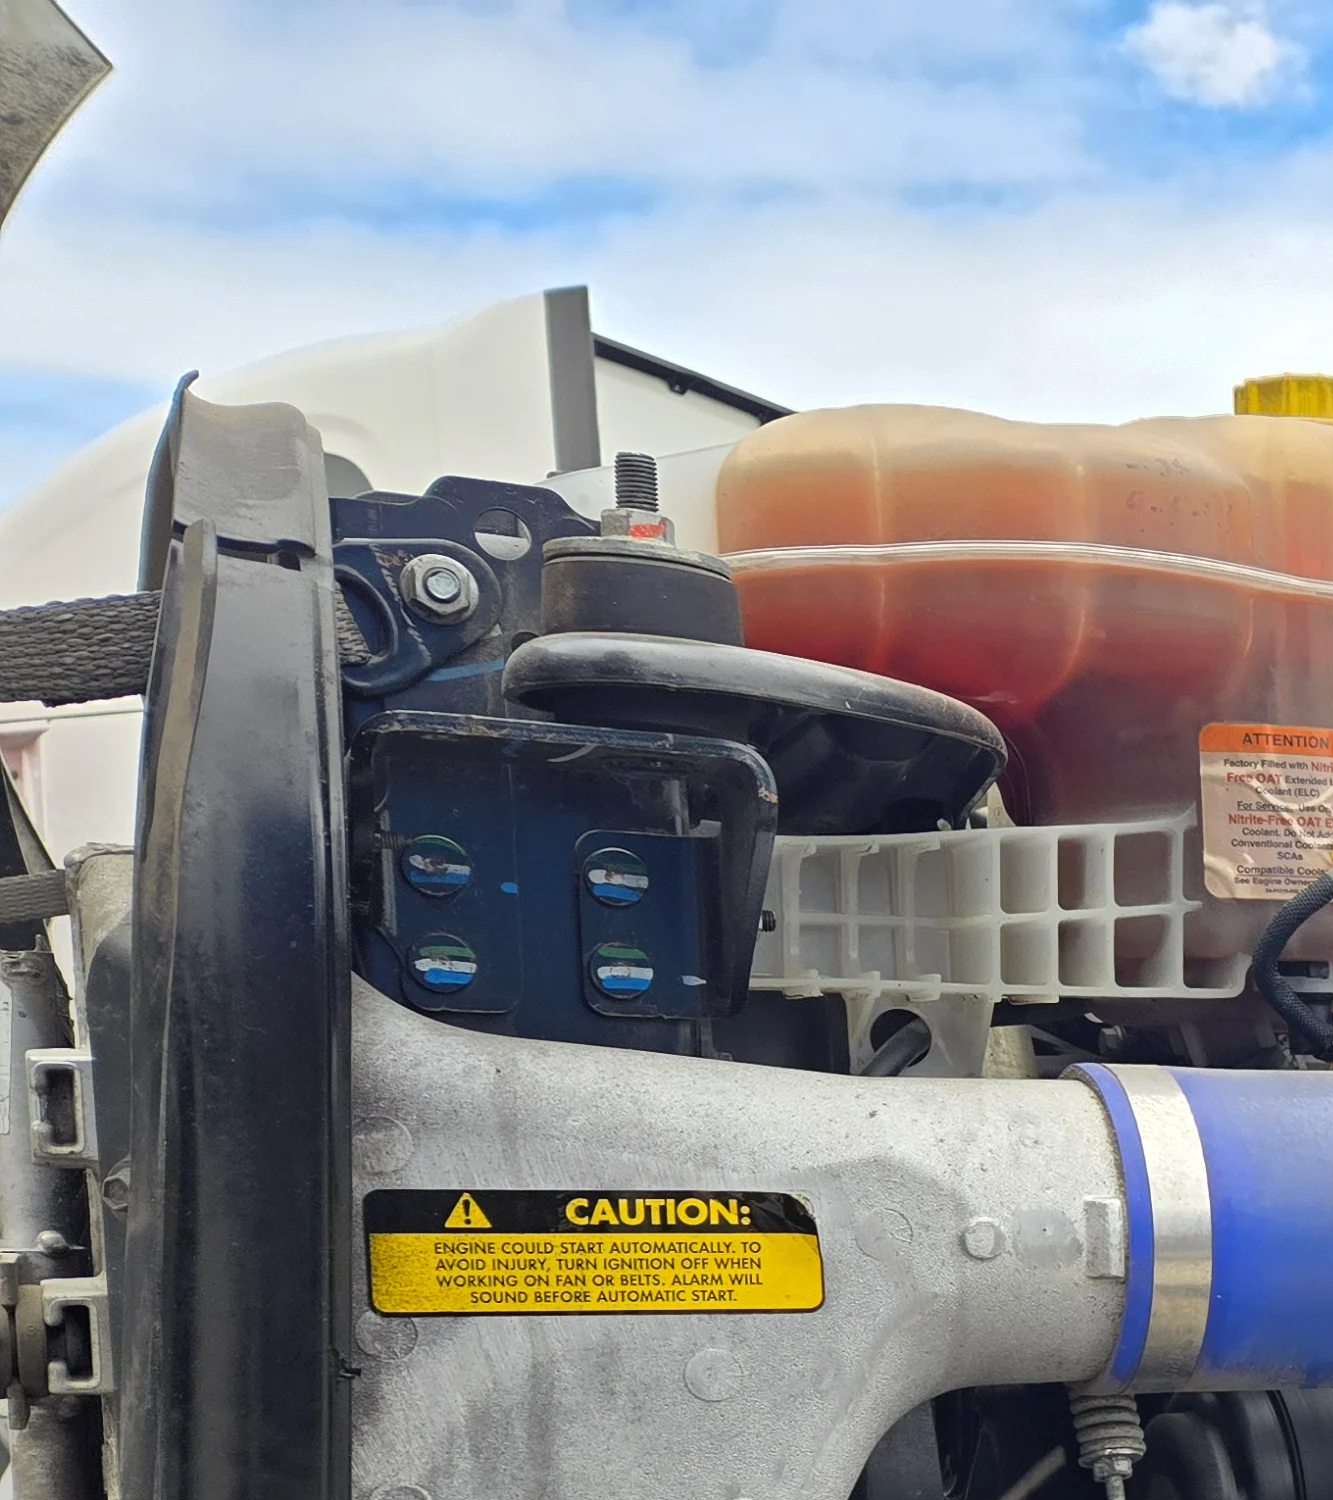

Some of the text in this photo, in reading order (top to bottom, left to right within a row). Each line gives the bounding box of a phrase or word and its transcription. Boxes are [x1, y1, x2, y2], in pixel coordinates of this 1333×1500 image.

[1243, 733, 1329, 749] ATTENTION
[1224, 759, 1259, 769] Factory
[1261, 759, 1287, 769] Filled
[1289, 762, 1308, 770] with
[1227, 773, 1253, 782] Free
[1256, 773, 1281, 784] OAT
[1285, 777, 1327, 785] Extended
[1255, 787, 1320, 798] Coolant (ELC)
[1237, 801, 1253, 811] For
[1299, 805, 1316, 813] Use
[1228, 814, 1293, 826] Nitrite-Free
[1297, 816, 1321, 827] OAT
[1284, 829, 1296, 837] Do
[1231, 839, 1292, 848] Conventional
[1277, 851, 1303, 861] SCAs
[1237, 865, 1327, 876] Compatible Coola
[1253, 877, 1282, 886] Engine
[1284, 878, 1313, 886] Owner
[565, 1197, 751, 1226] CAUTION:
[434, 1241, 761, 1255] ENGINE COULD START AUTOMATICALLY. TO
[435, 1257, 761, 1273] AVOID INJURY, TURN IGNITION OFF WHEN
[436, 1273, 763, 1287] WORKING ON FAN OR BELTS. ALARM WILL
[470, 1290, 738, 1304] SOUND BEFORE AUTOMATIC START.
